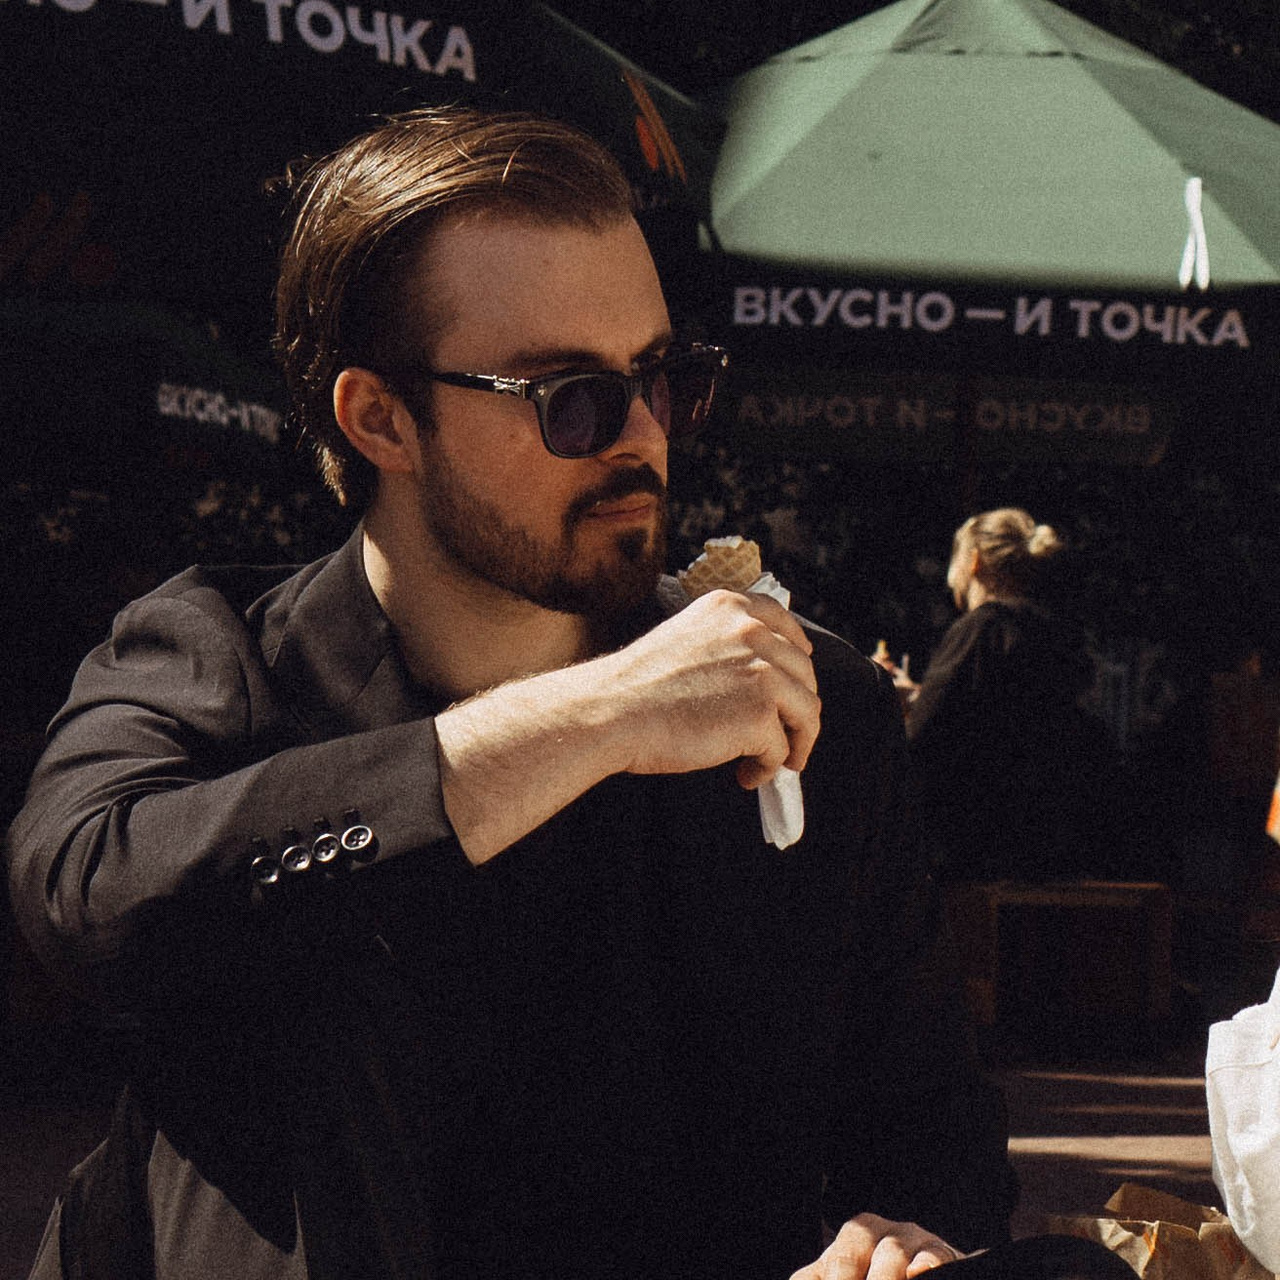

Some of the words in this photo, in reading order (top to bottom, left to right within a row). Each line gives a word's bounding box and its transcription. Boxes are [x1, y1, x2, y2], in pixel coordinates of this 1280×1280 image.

[733, 287, 955, 332] ВКУСНО
[1014, 297, 1052, 336] И
[1069, 299, 1251, 349] ТОЧКА
